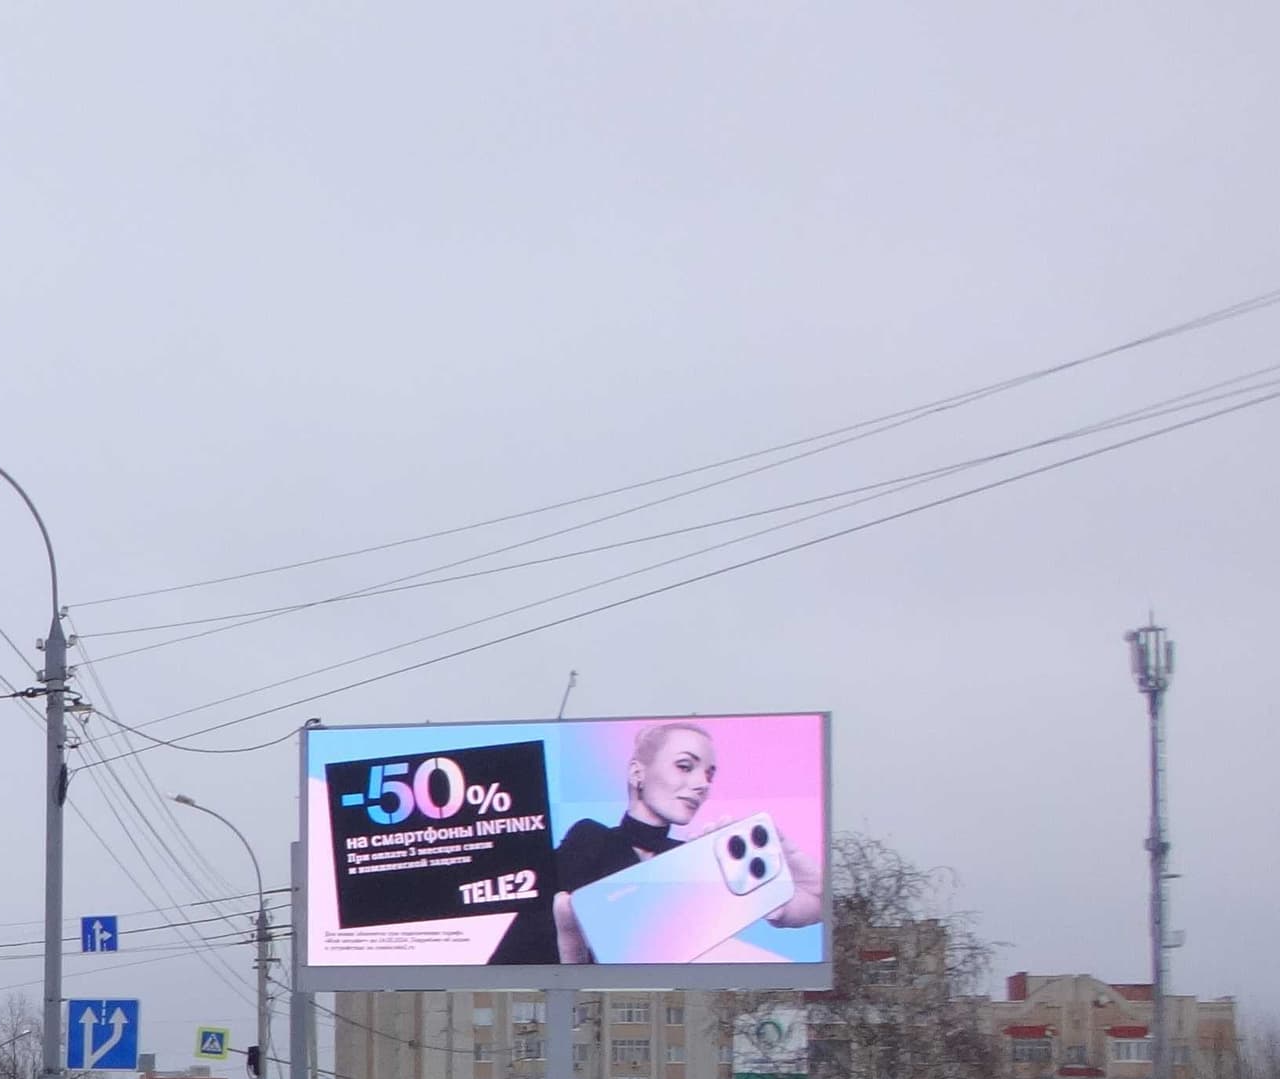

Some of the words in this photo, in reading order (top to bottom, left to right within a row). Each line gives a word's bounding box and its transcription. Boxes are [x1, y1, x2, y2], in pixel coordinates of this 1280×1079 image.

[341, 757, 512, 825] -50%
[346, 835, 368, 850] на
[371, 825, 473, 847] смартфоны
[476, 815, 545, 836] INFINIX
[459, 870, 538, 904] TELE2
